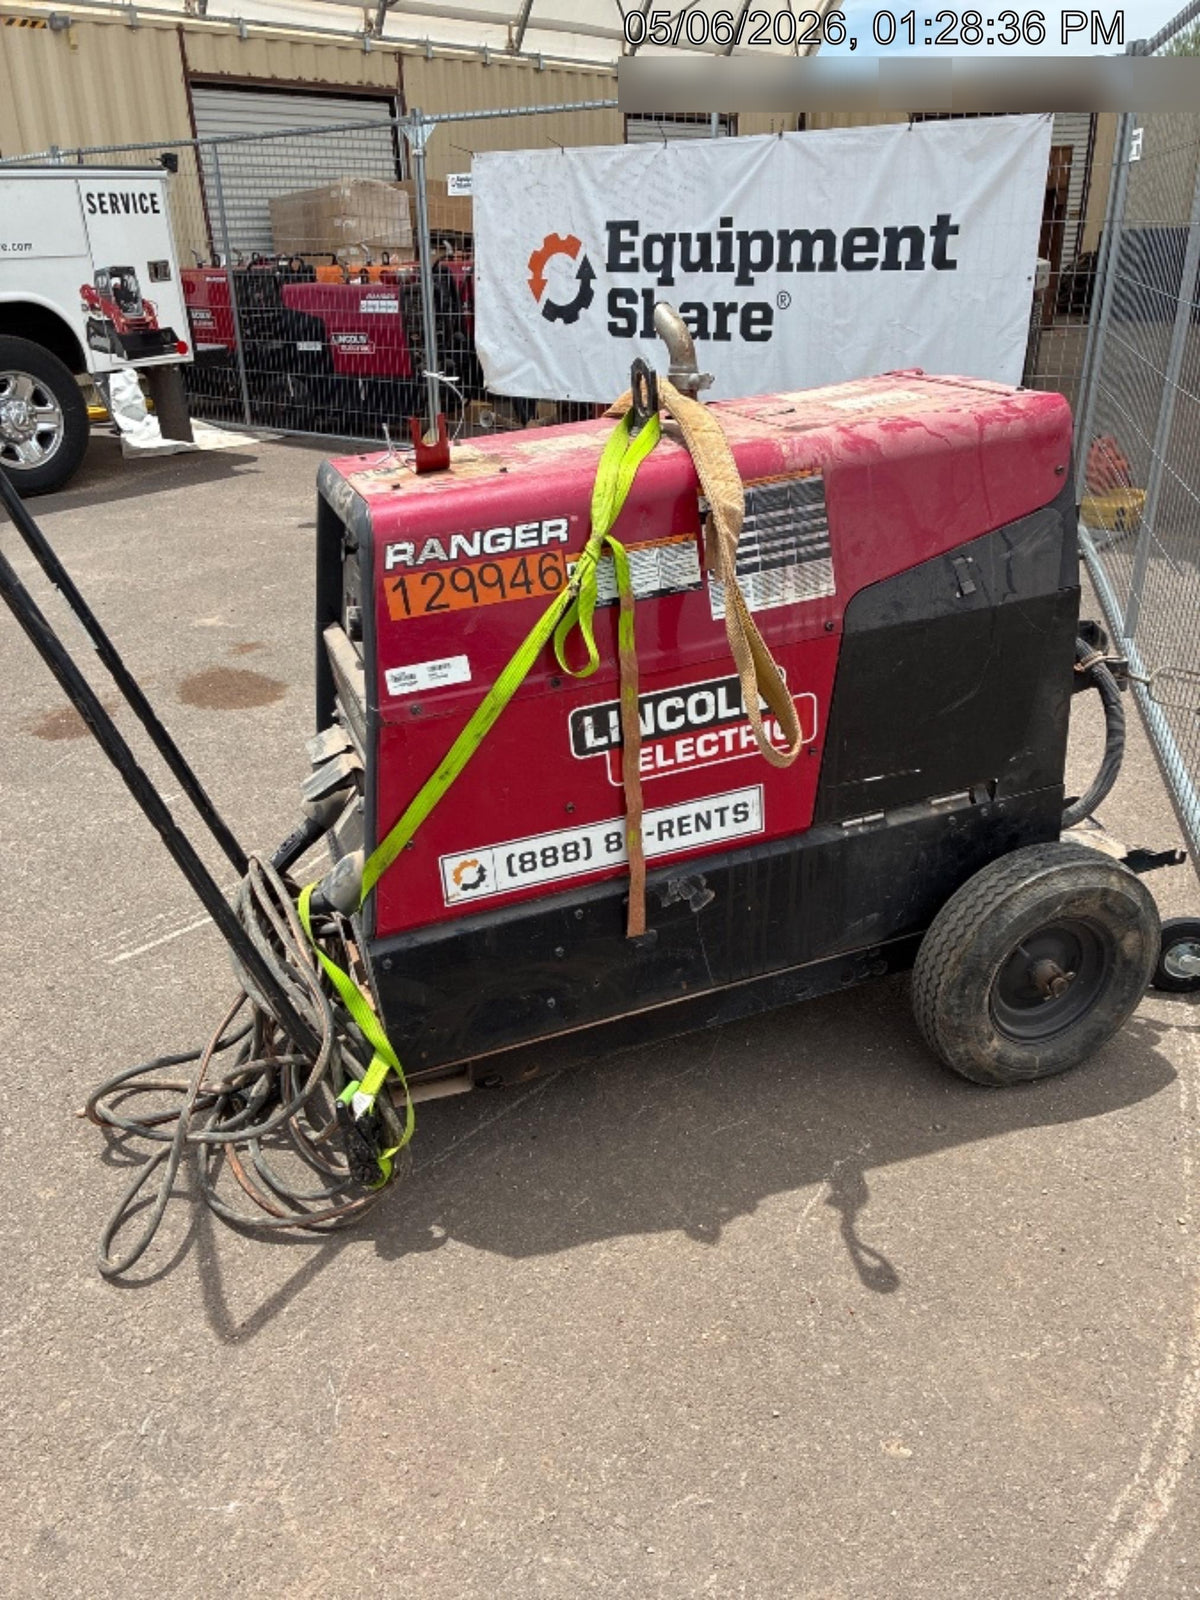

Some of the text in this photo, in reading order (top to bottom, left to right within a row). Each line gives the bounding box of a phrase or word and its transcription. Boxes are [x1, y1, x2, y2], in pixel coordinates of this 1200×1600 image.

[86, 192, 161, 214] SERVICE
[0, 242, 33, 252] e.com
[605, 213, 960, 286] Equipment
[384, 517, 570, 571] RANGER
[392, 552, 563, 616] 129946
[505, 801, 750, 877] (888) 8-RENTS
